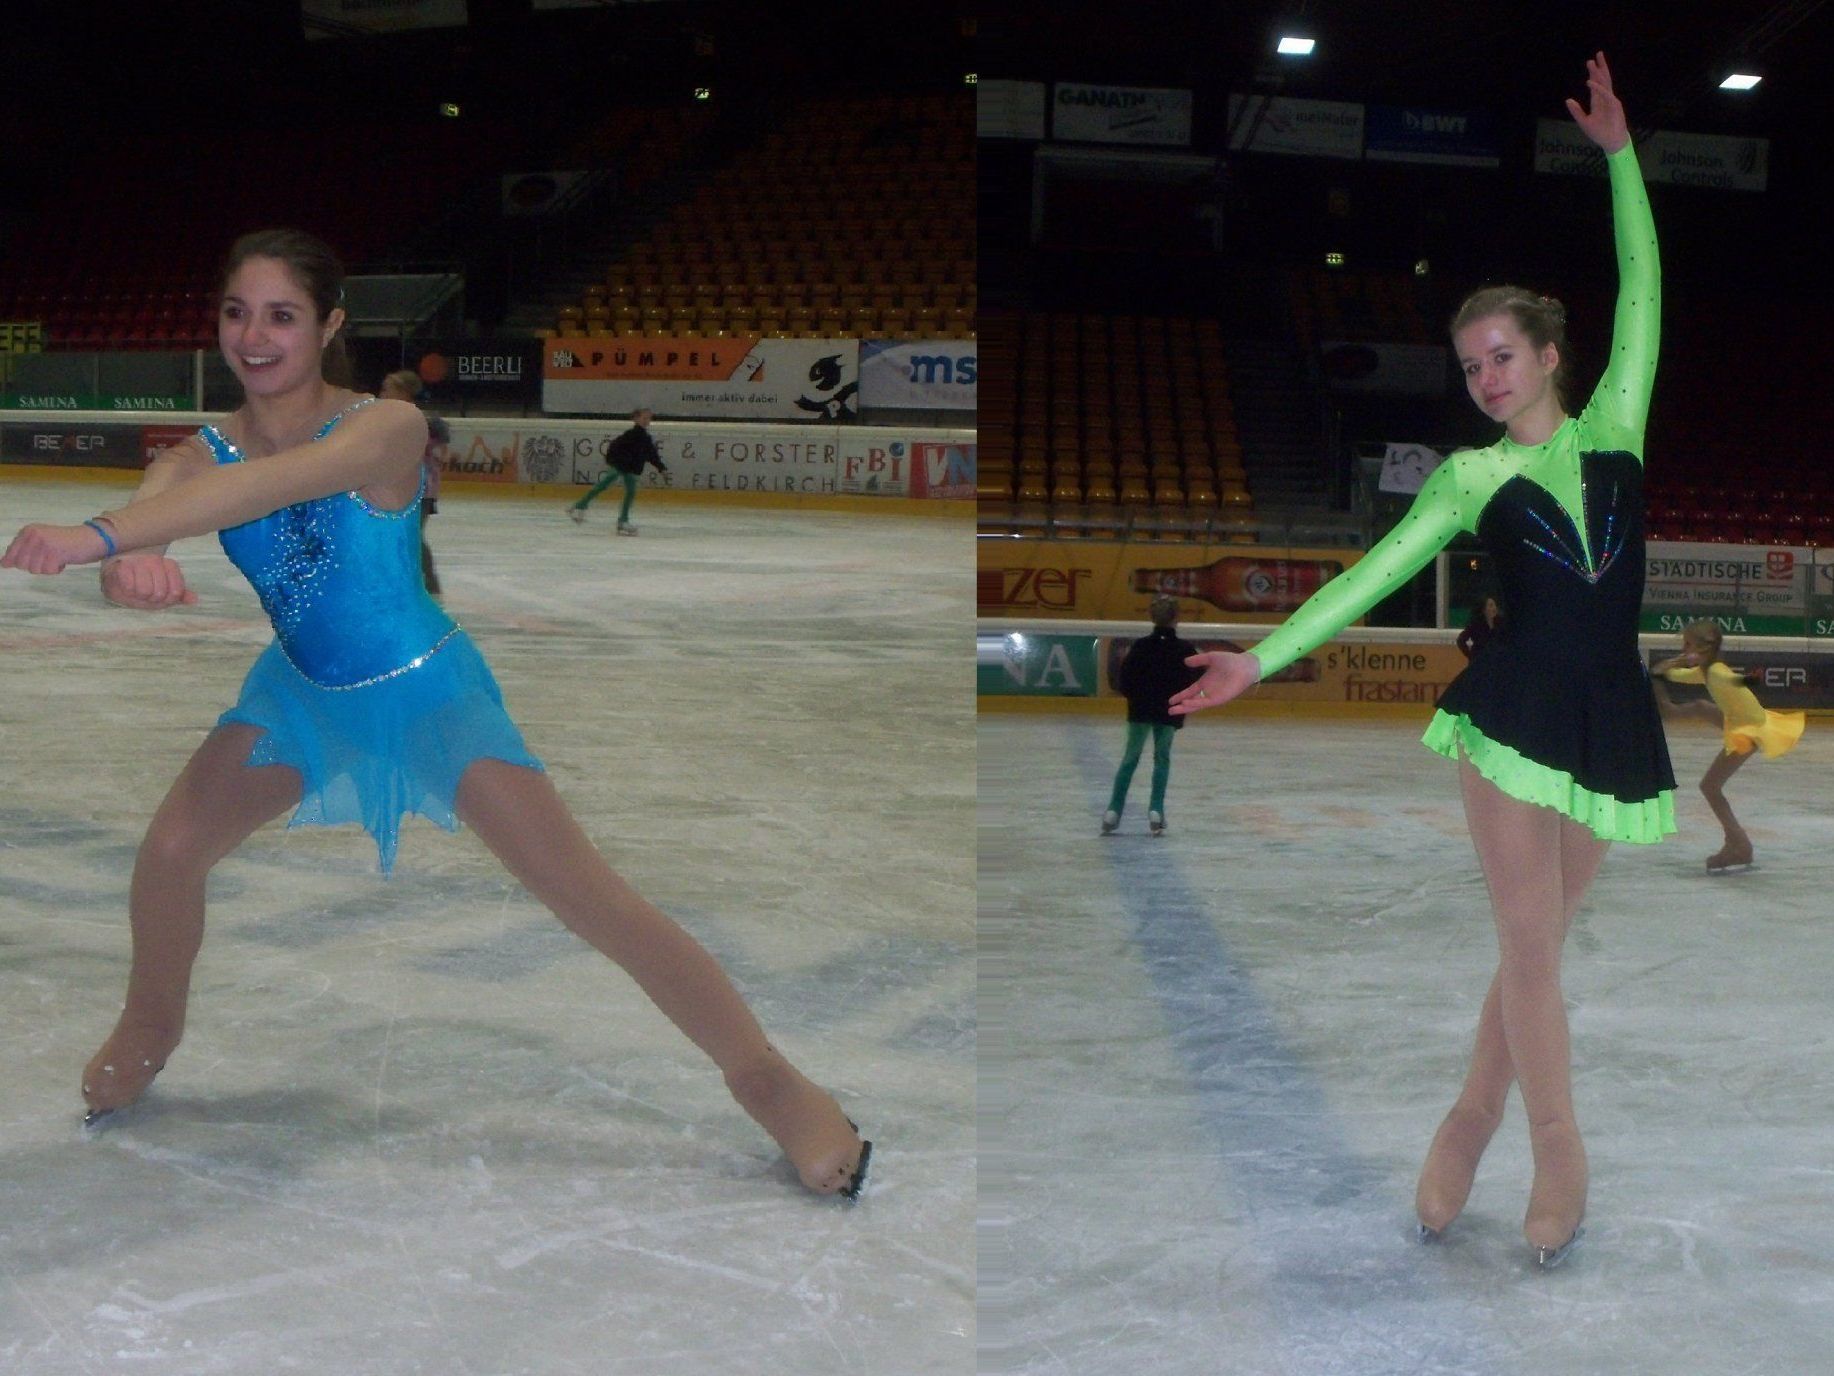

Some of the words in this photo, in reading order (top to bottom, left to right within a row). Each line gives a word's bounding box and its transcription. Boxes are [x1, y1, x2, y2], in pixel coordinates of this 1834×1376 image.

[1661, 149, 1723, 169] Johnson
[1671, 169, 1734, 188] Controls
[457, 355, 522, 374] BEERLI
[592, 348, 720, 367] PÜMPEL
[19, 396, 77, 409] SAMINA
[114, 398, 175, 409] SAMINA
[714, 442, 835, 464] FORSTER
[693, 473, 834, 492] FELDKIRCH
